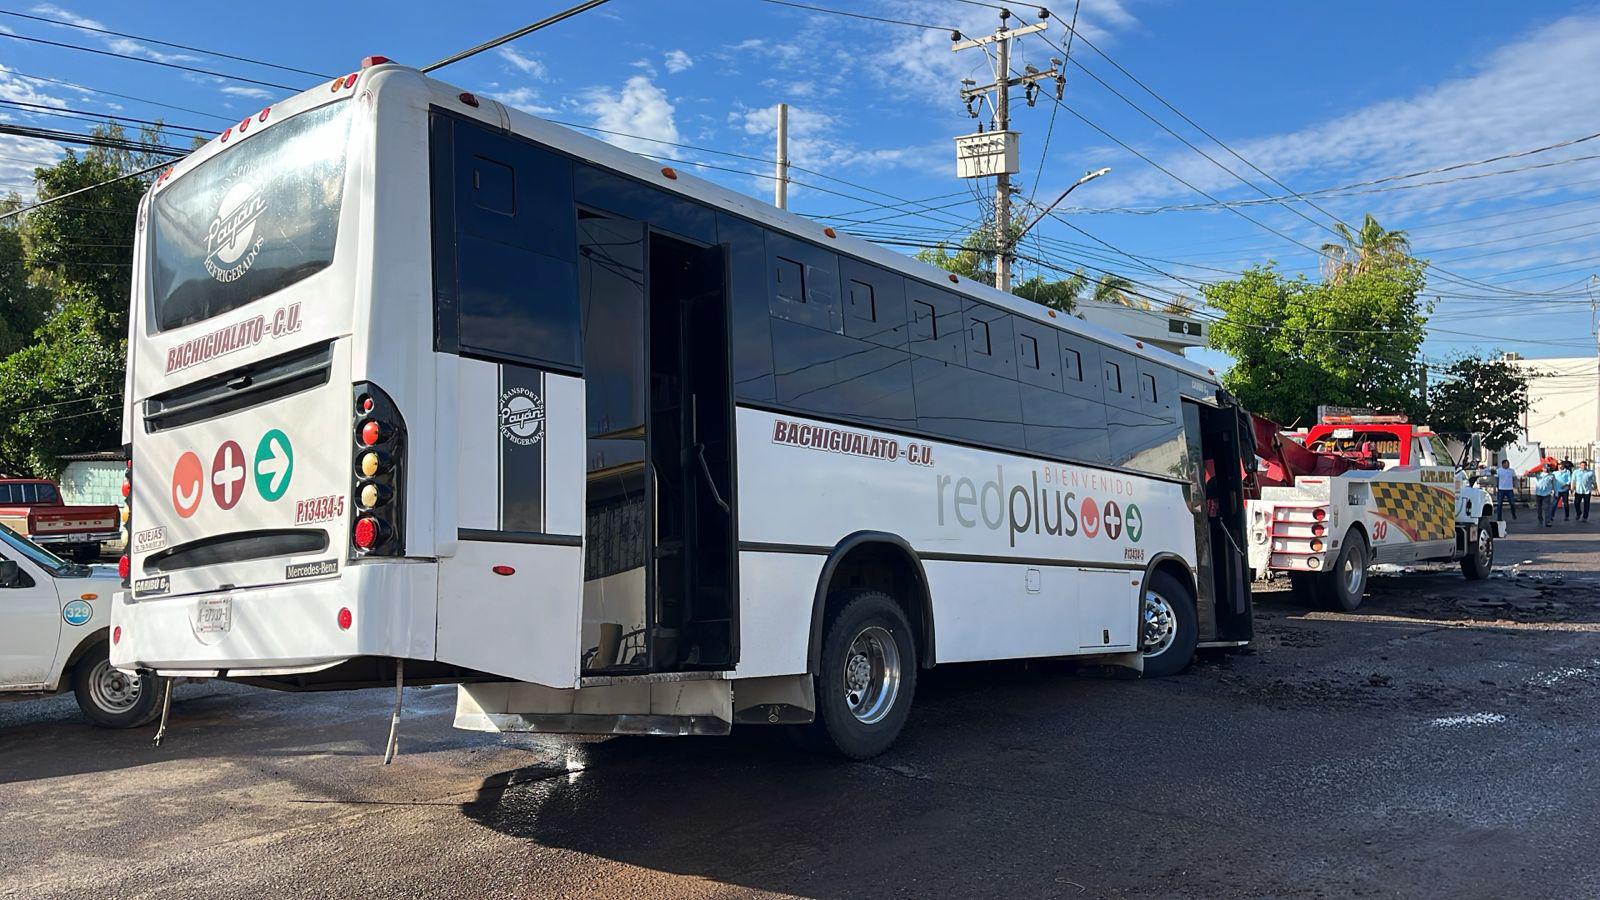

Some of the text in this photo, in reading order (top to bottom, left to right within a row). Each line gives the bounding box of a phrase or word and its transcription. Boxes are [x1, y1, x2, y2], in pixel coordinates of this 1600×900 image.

[204, 235, 264, 282] REFRIGERADOS
[500, 387, 544, 410] TRANSPORTES
[500, 424, 544, 445] REFRIGERADOS
[1044, 466, 1133, 497] BIENVENIDO
[138, 528, 162, 544] QUEJAS
[1372, 520, 1387, 541] 30
[287, 561, 337, 578] Mercedes-Benz
[67, 607, 89, 618] 329
